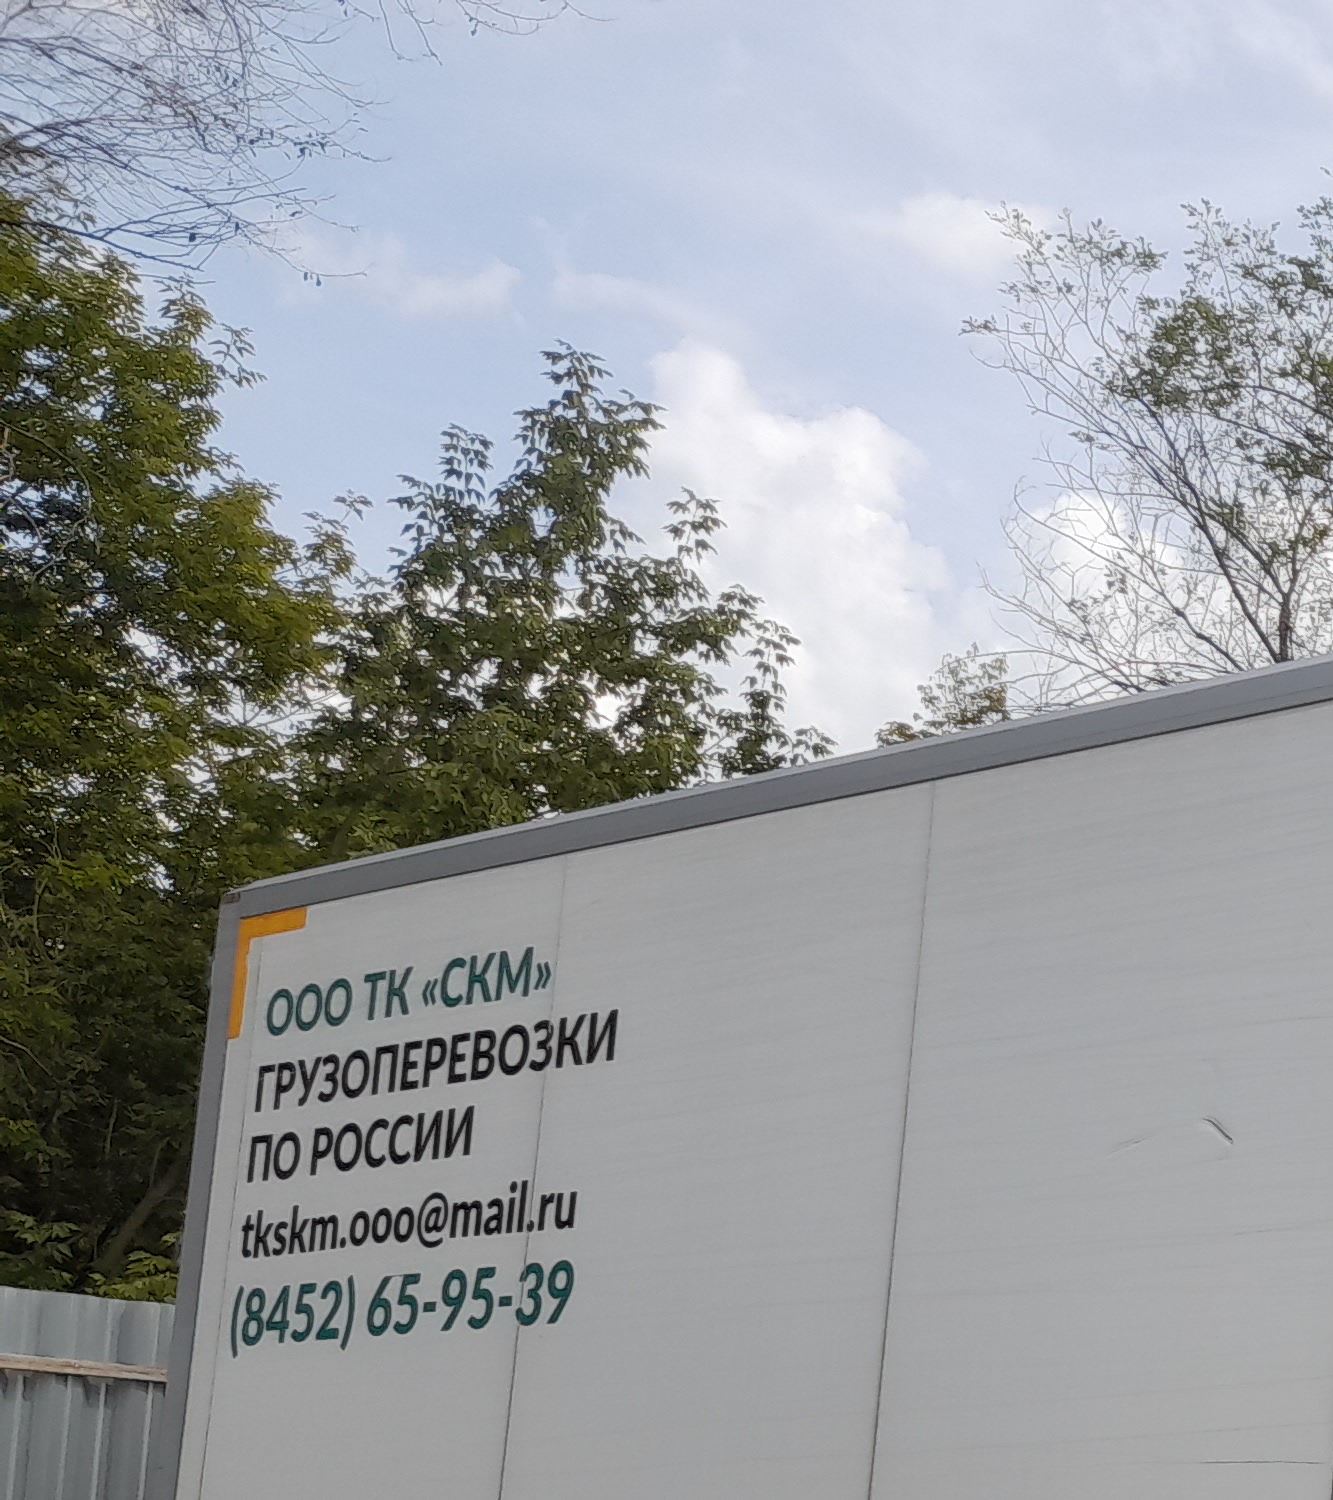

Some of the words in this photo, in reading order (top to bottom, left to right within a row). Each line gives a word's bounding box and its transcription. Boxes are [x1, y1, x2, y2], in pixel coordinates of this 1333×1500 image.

[266, 978, 352, 1036] ООО
[364, 966, 413, 1020] ТК
[422, 947, 551, 1008] «СКМ»
[255, 1009, 618, 1112] ГРУЗОПЕРЕВОЗКИ
[247, 1132, 301, 1183] ПО
[310, 1106, 475, 1176] РОССИИ
[241, 1180, 577, 1258] tkskm.ooo@mail.ru
[231, 1275, 355, 1358] (8452)
[367, 1260, 574, 1336] 65-95-39
